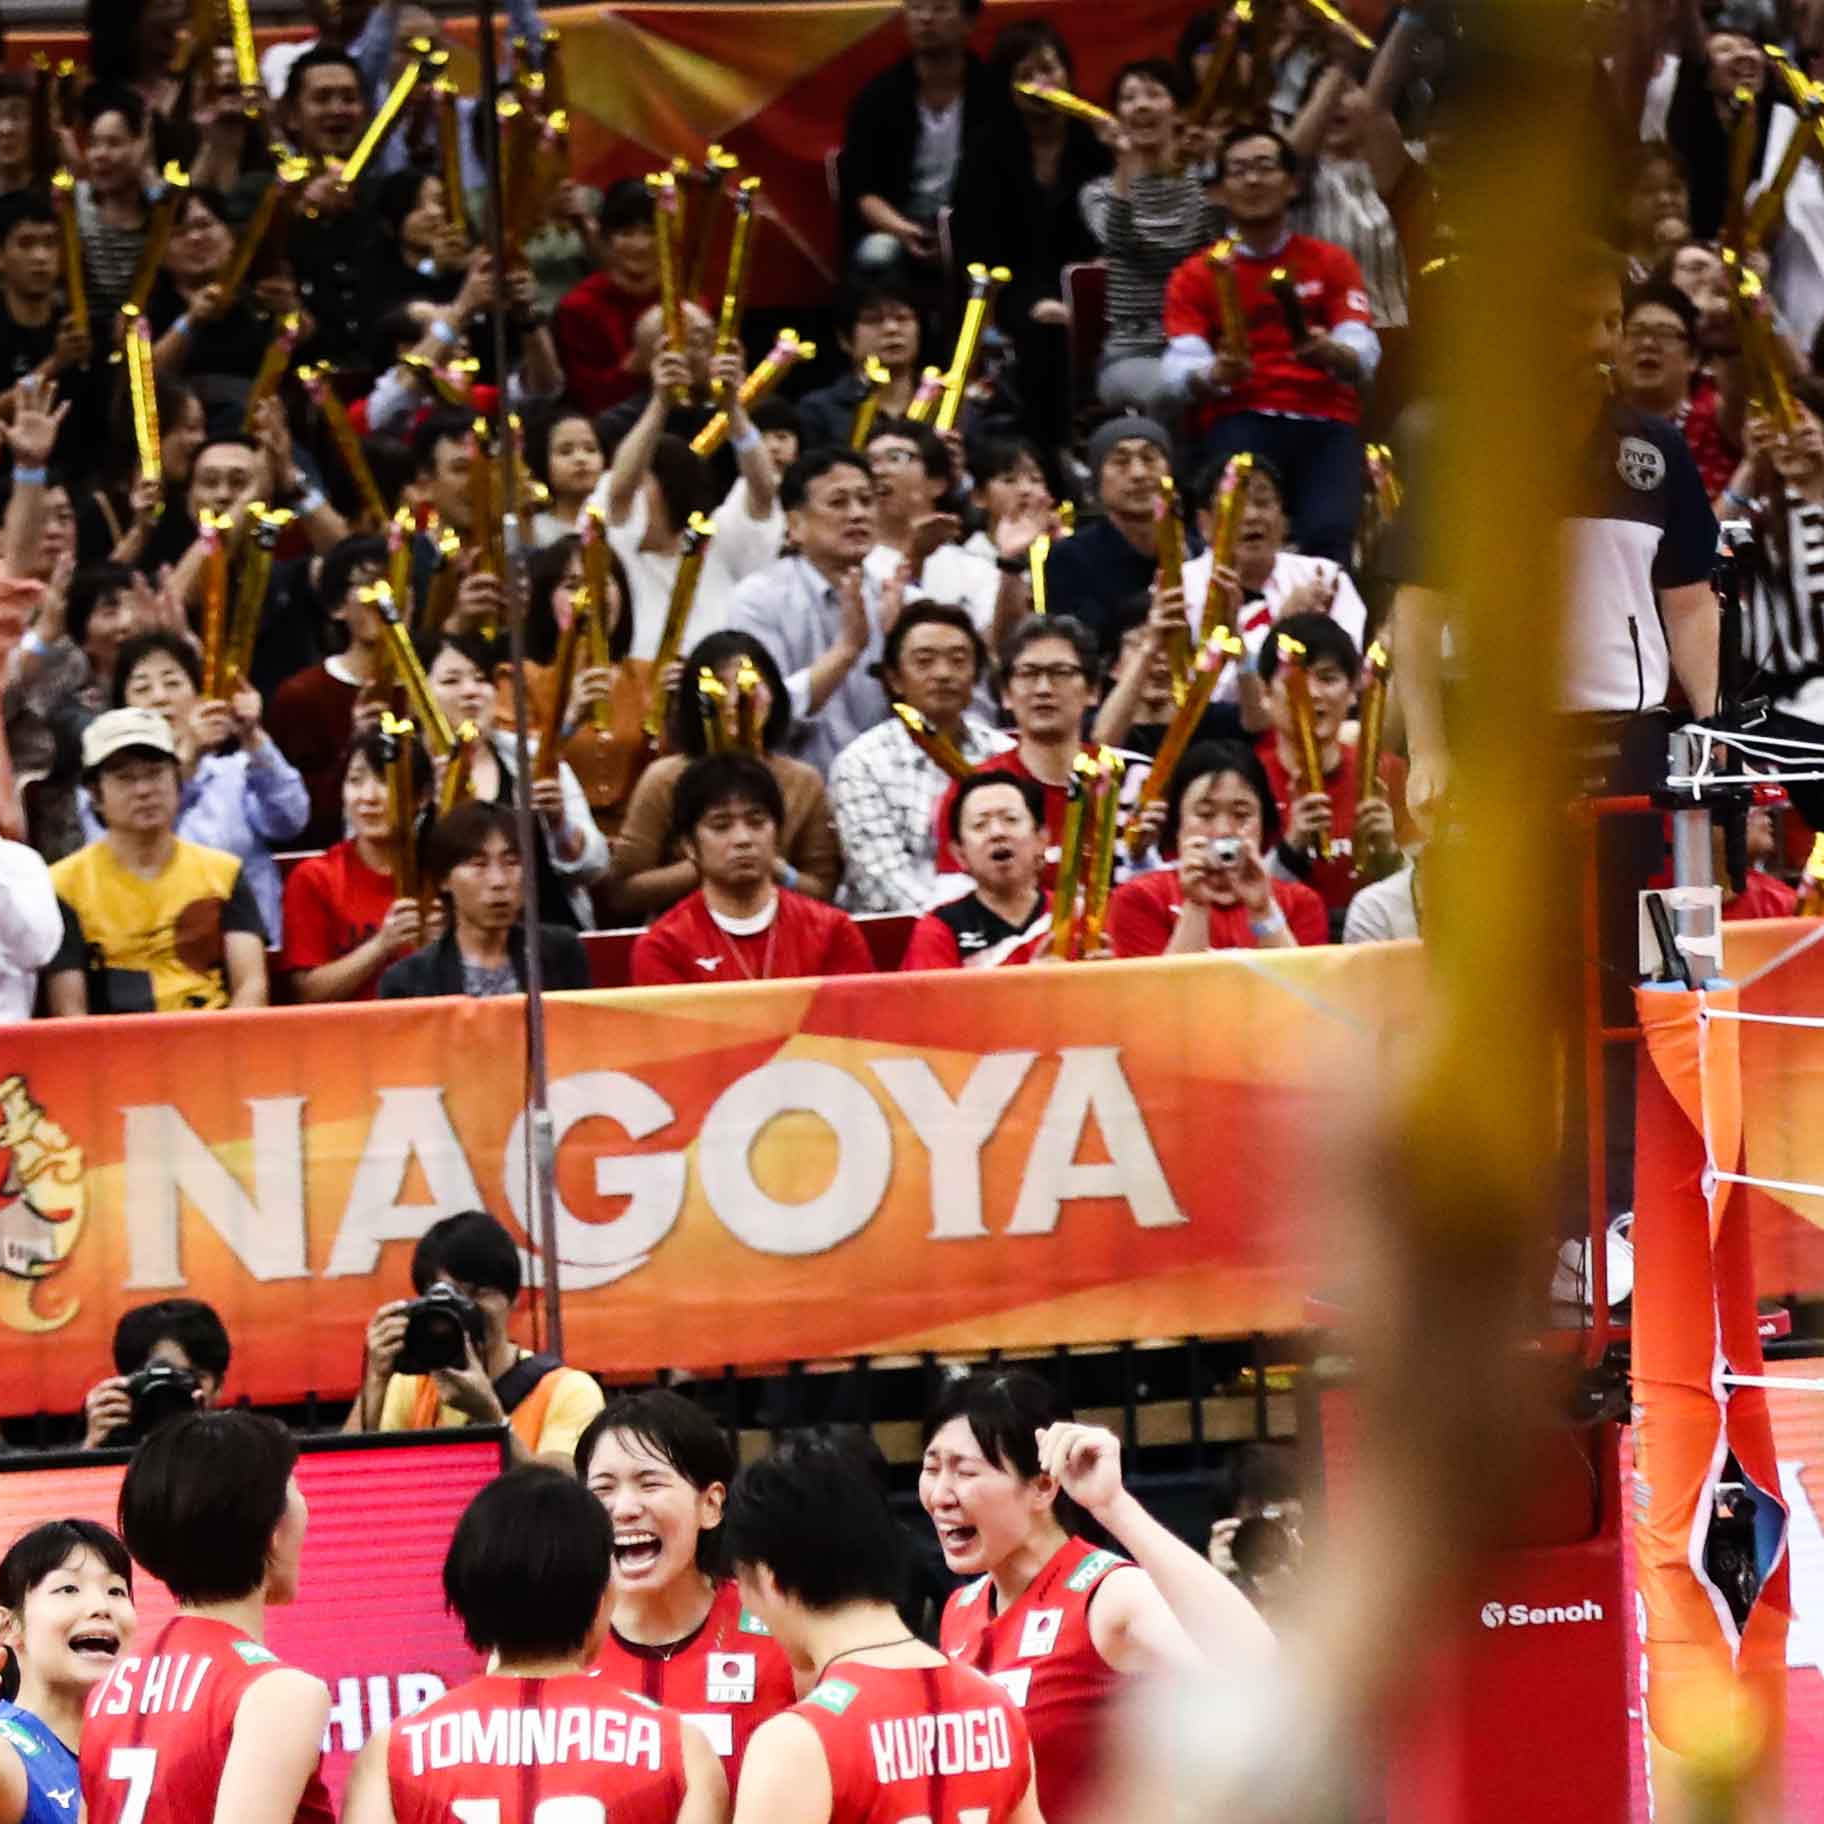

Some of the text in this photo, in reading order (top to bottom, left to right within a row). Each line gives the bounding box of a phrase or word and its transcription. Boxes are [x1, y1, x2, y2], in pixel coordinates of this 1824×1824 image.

[121, 1047, 1188, 1290] NAGOYA
[1506, 1598, 1604, 1627] Senoh
[90, 1654, 213, 1718] ISHII
[401, 1706, 661, 1776] TOMINAGA
